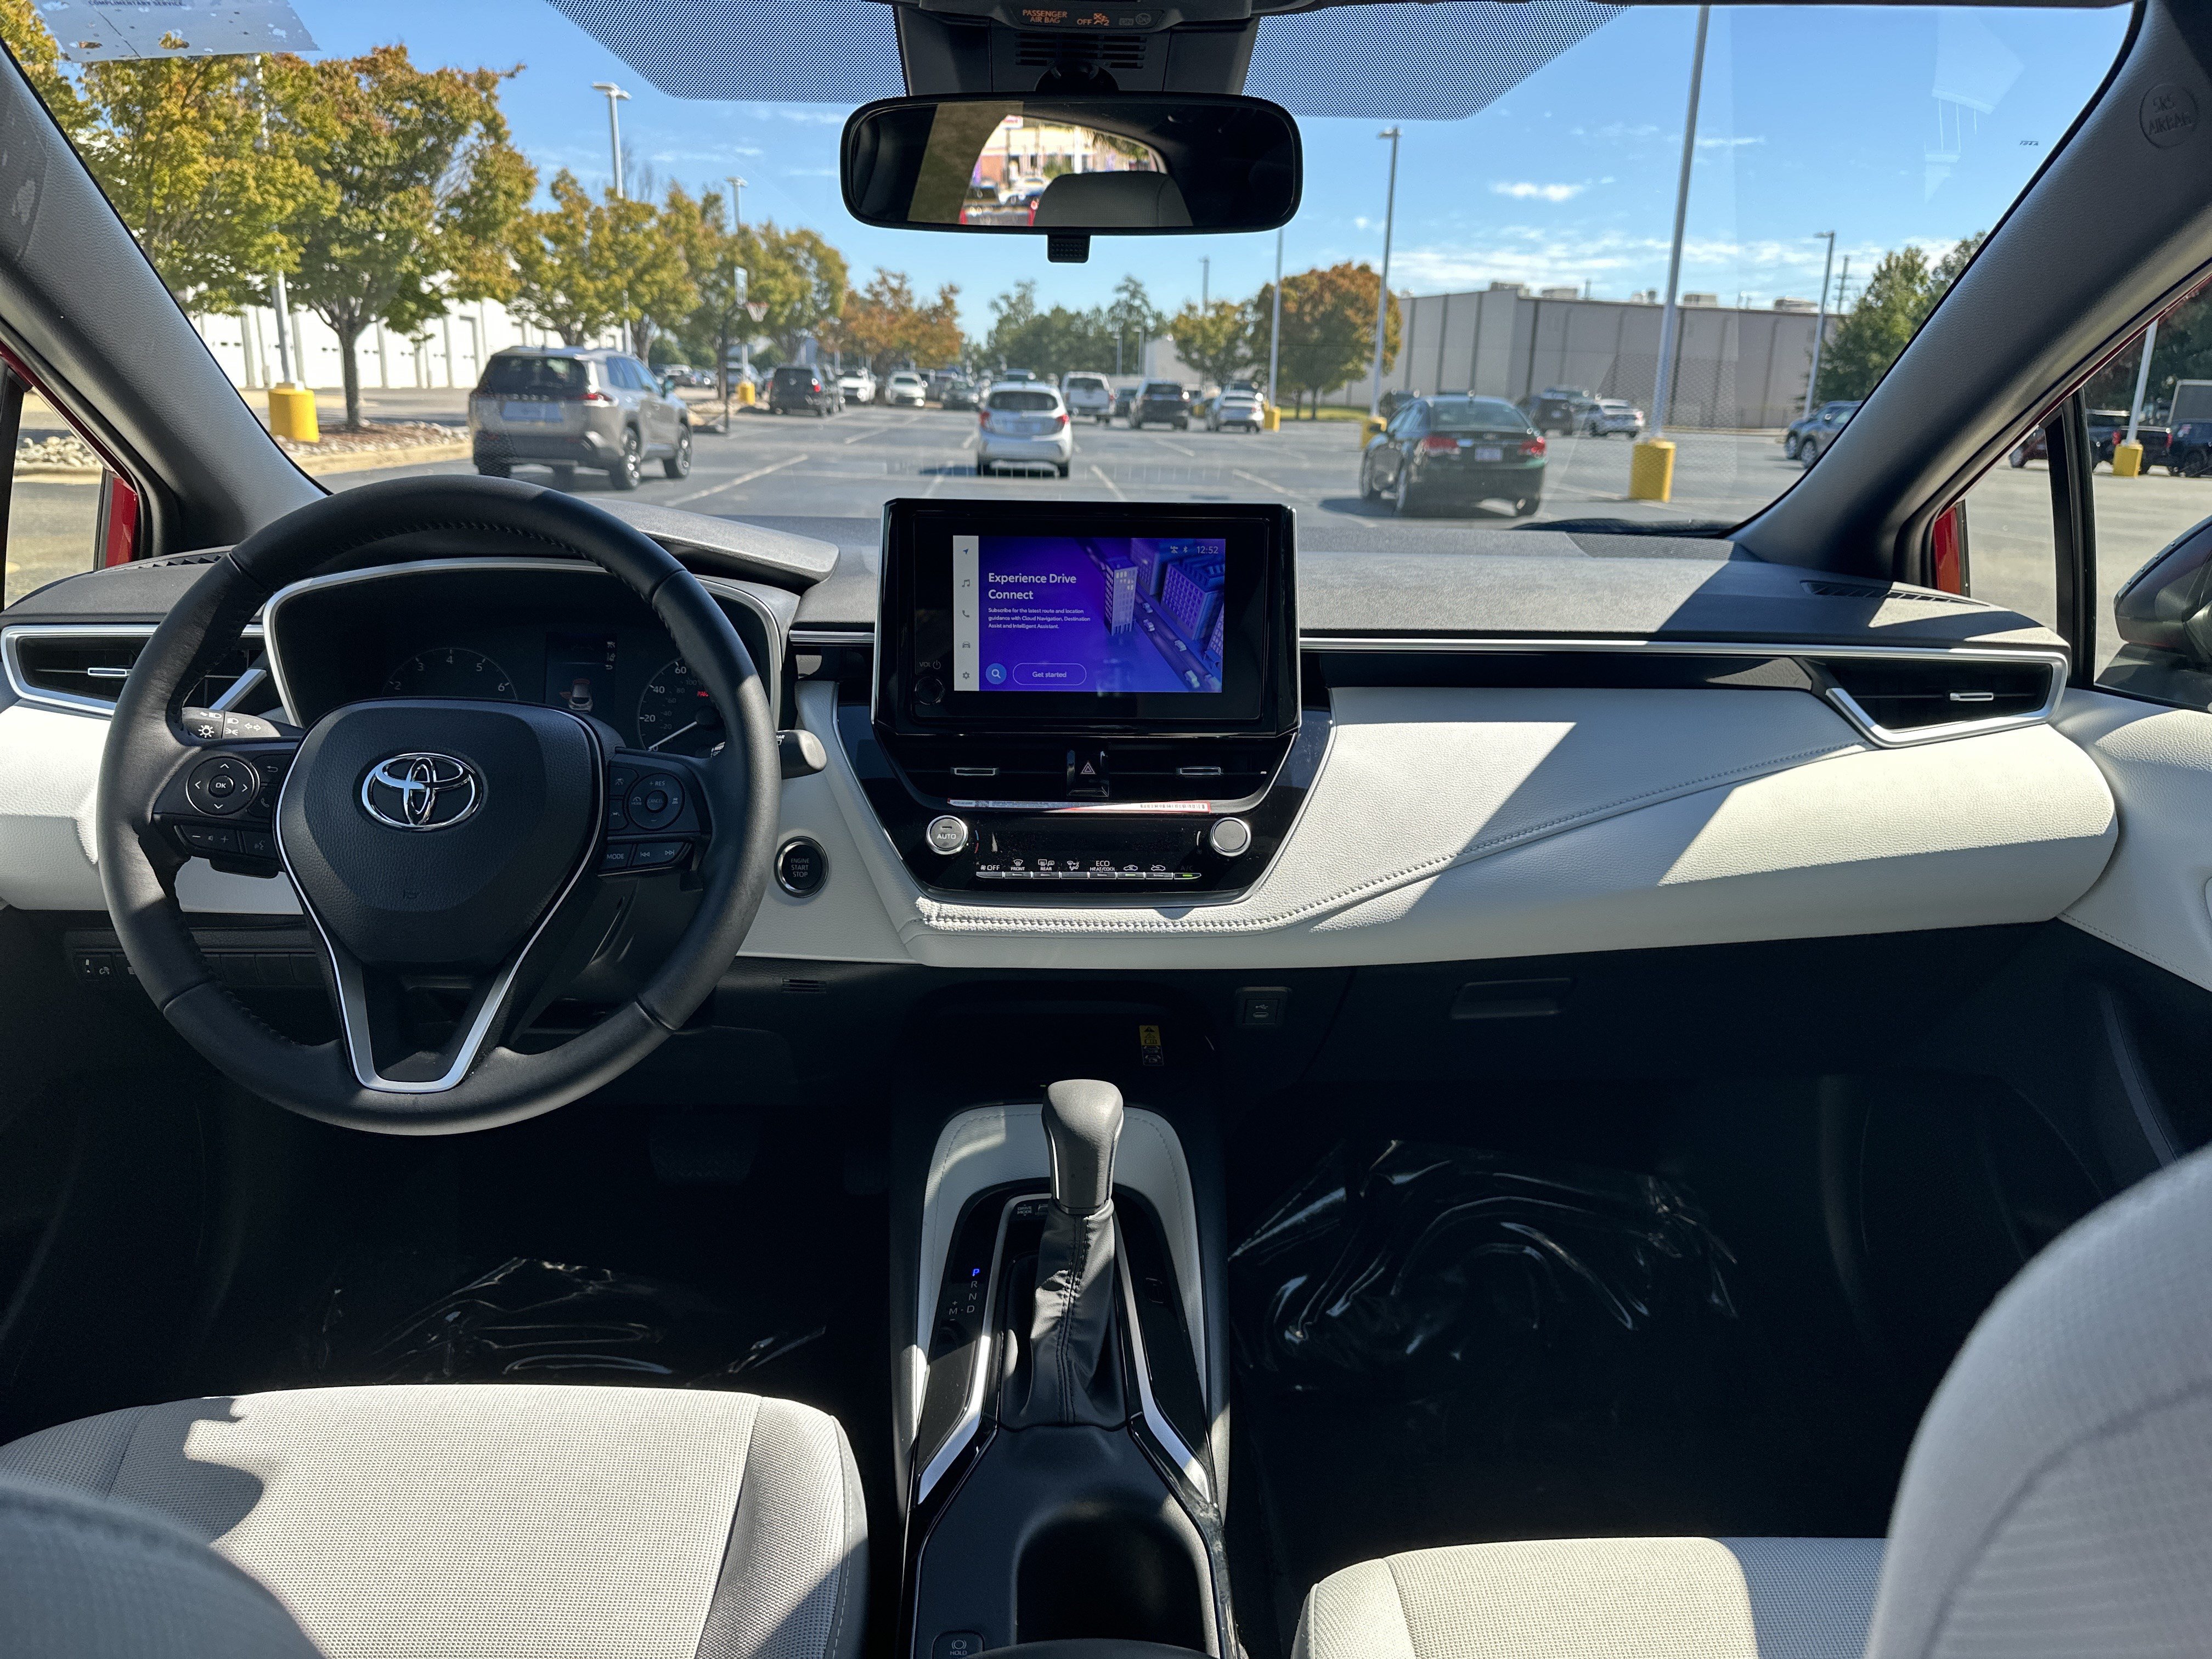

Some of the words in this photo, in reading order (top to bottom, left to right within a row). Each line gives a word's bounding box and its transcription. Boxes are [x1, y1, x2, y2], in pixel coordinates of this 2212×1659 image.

[1022, 9, 1068, 18] PASSENGER
[1197, 546, 1218, 554] 12:52
[989, 573, 1047, 585] Experience
[1049, 573, 1077, 583] Drive
[988, 589, 1034, 600] Connect
[446, 656, 453, 664] 4
[417, 663, 424, 671] 3
[476, 663, 483, 672] 5
[394, 681, 401, 690] 2
[498, 683, 505, 691] 6
[972, 1268, 980, 1277] P
[971, 1280, 978, 1289] R
[969, 1293, 977, 1301] N
[949, 1307, 958, 1316] M
[967, 1305, 975, 1313] D
